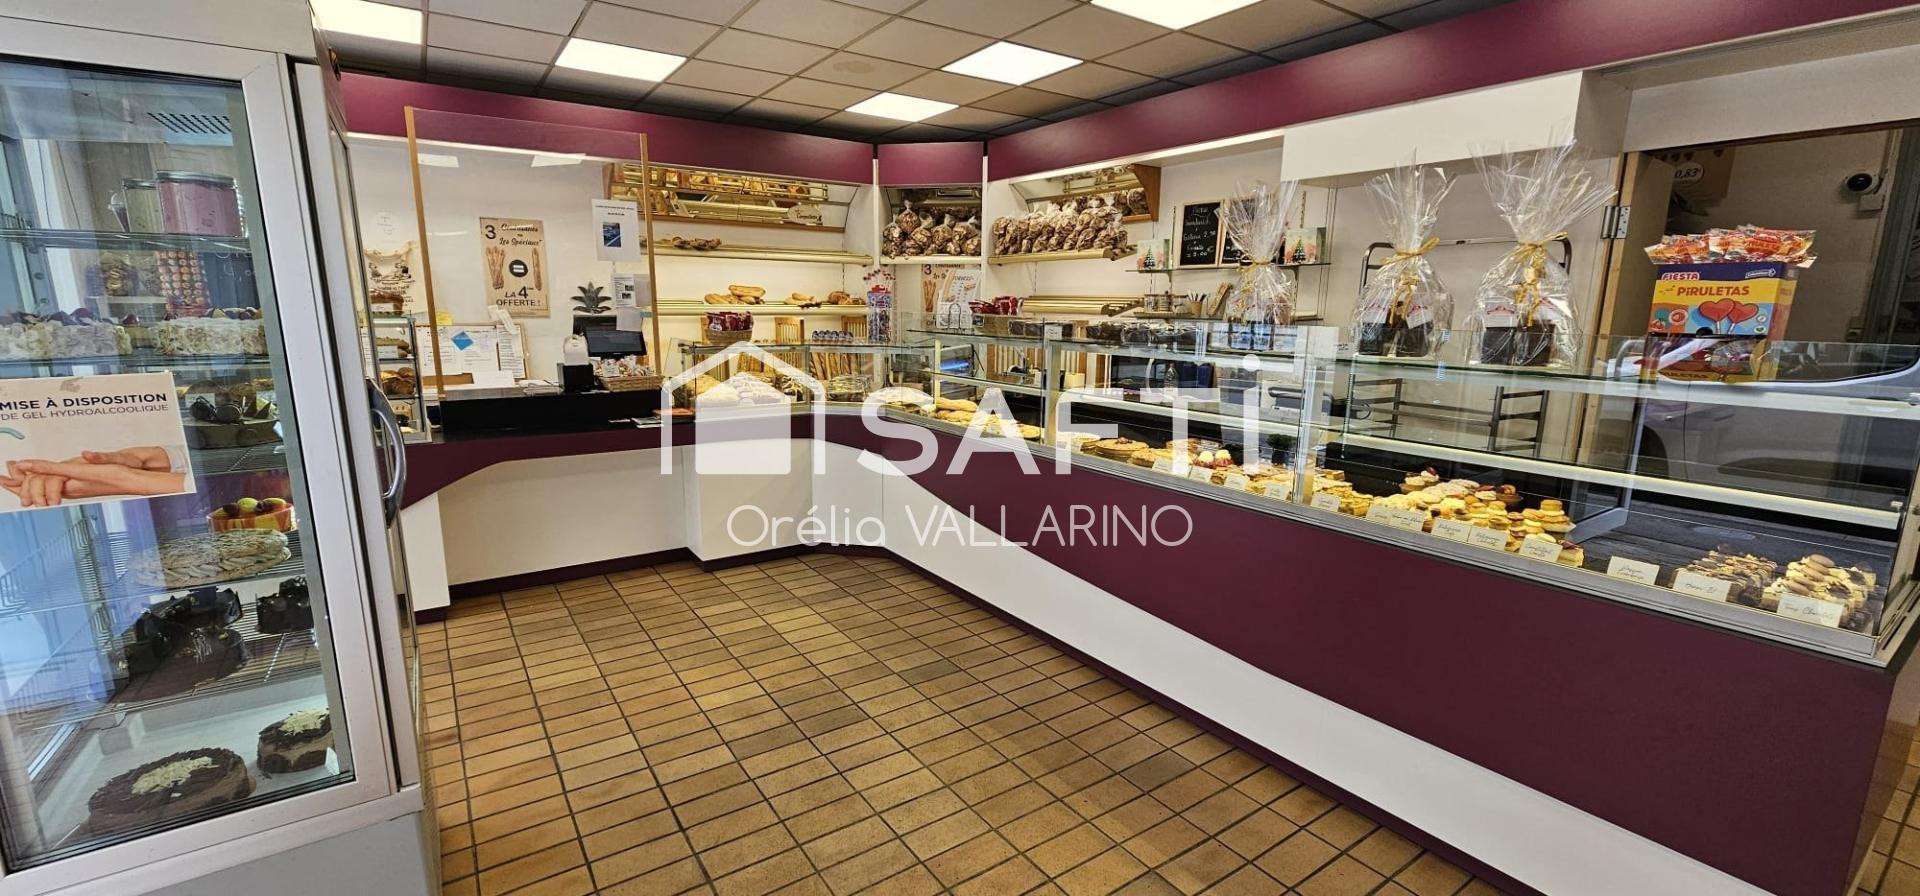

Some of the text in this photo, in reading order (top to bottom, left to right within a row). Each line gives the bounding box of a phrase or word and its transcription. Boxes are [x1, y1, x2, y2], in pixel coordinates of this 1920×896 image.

[485, 225, 496, 239] 3
[924, 264, 932, 275] 3
[1662, 272, 1699, 280] FIESTA
[1677, 285, 1750, 296] PIRULETAS
[0, 393, 167, 411] MISE À DISPOSITION
[1, 404, 169, 421] DE GEL HYDROALCOOLIQUE
